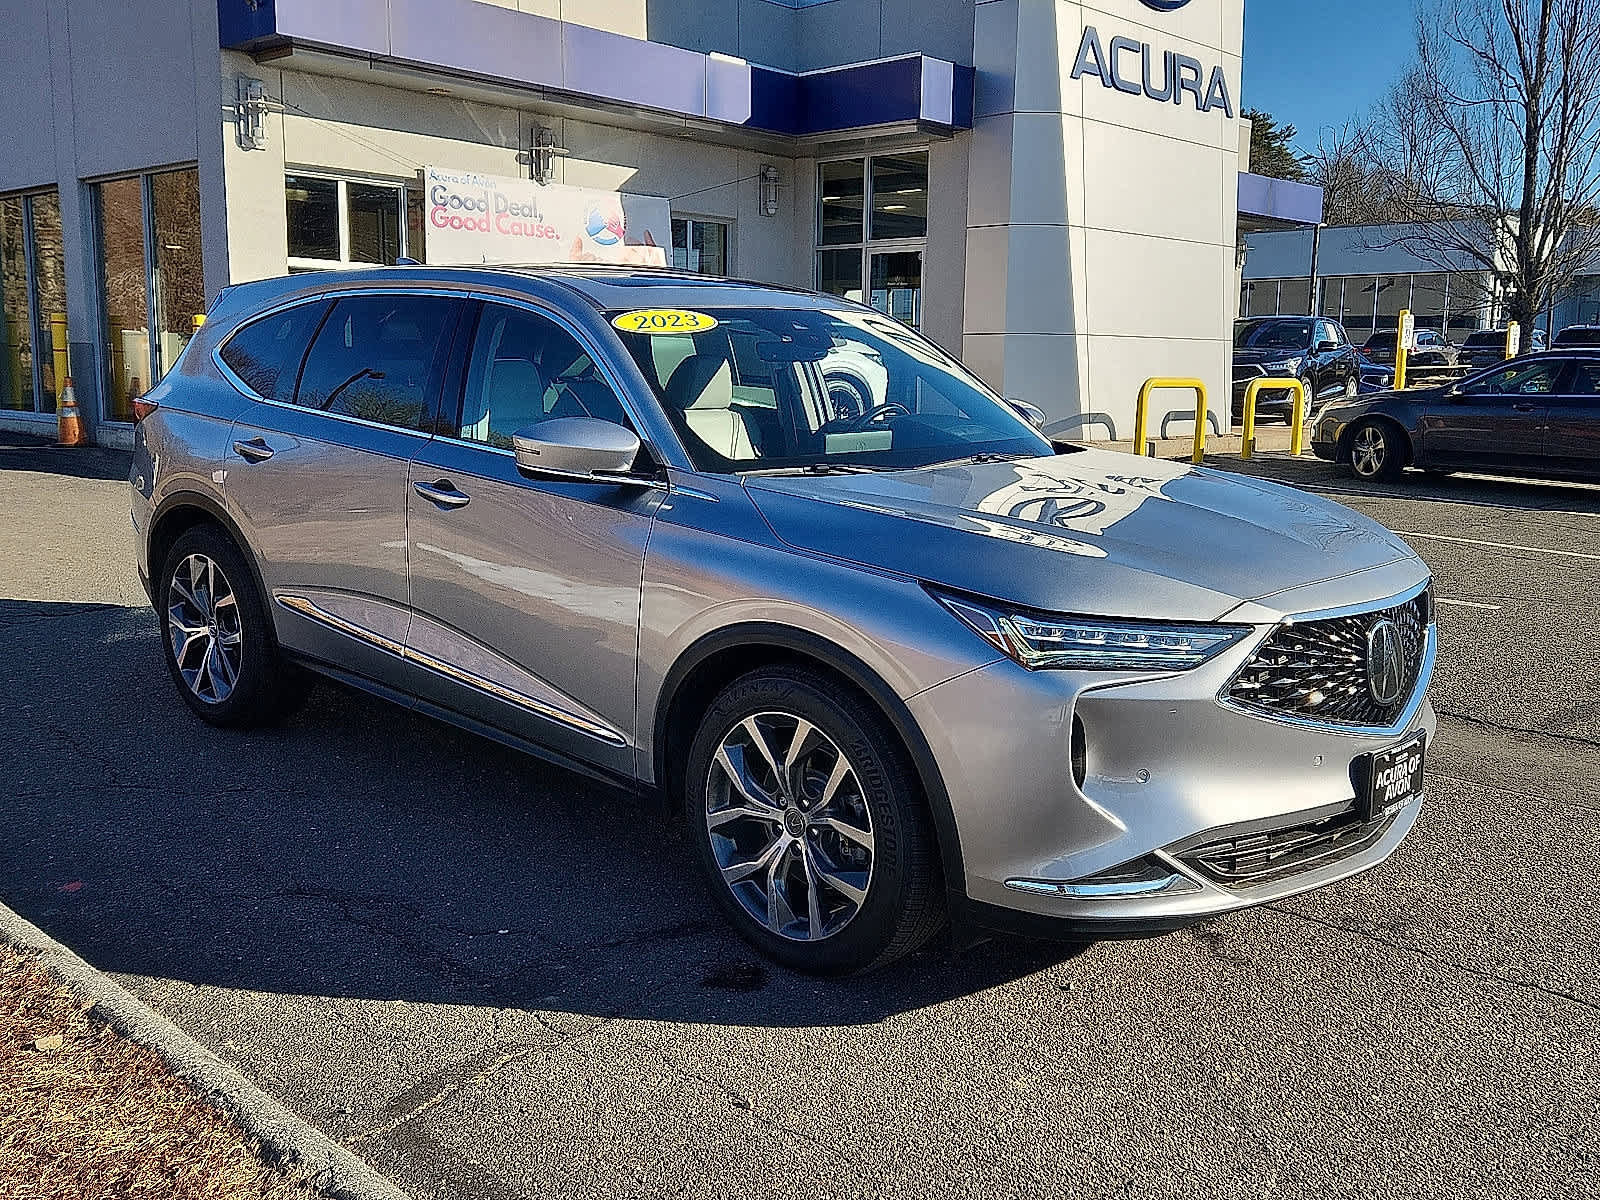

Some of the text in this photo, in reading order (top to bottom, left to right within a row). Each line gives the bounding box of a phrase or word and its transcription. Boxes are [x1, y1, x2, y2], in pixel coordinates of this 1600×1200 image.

[1070, 25, 1233, 119] ACURA
[429, 169, 459, 184] Acura
[460, 173, 471, 184] of
[430, 184, 544, 222] Good Deal,
[430, 205, 561, 240] Good Cause.
[633, 313, 699, 329] 2023
[1375, 761, 1408, 790] ACURA
[1408, 753, 1421, 774] OF
[1384, 774, 1412, 802] AVON
